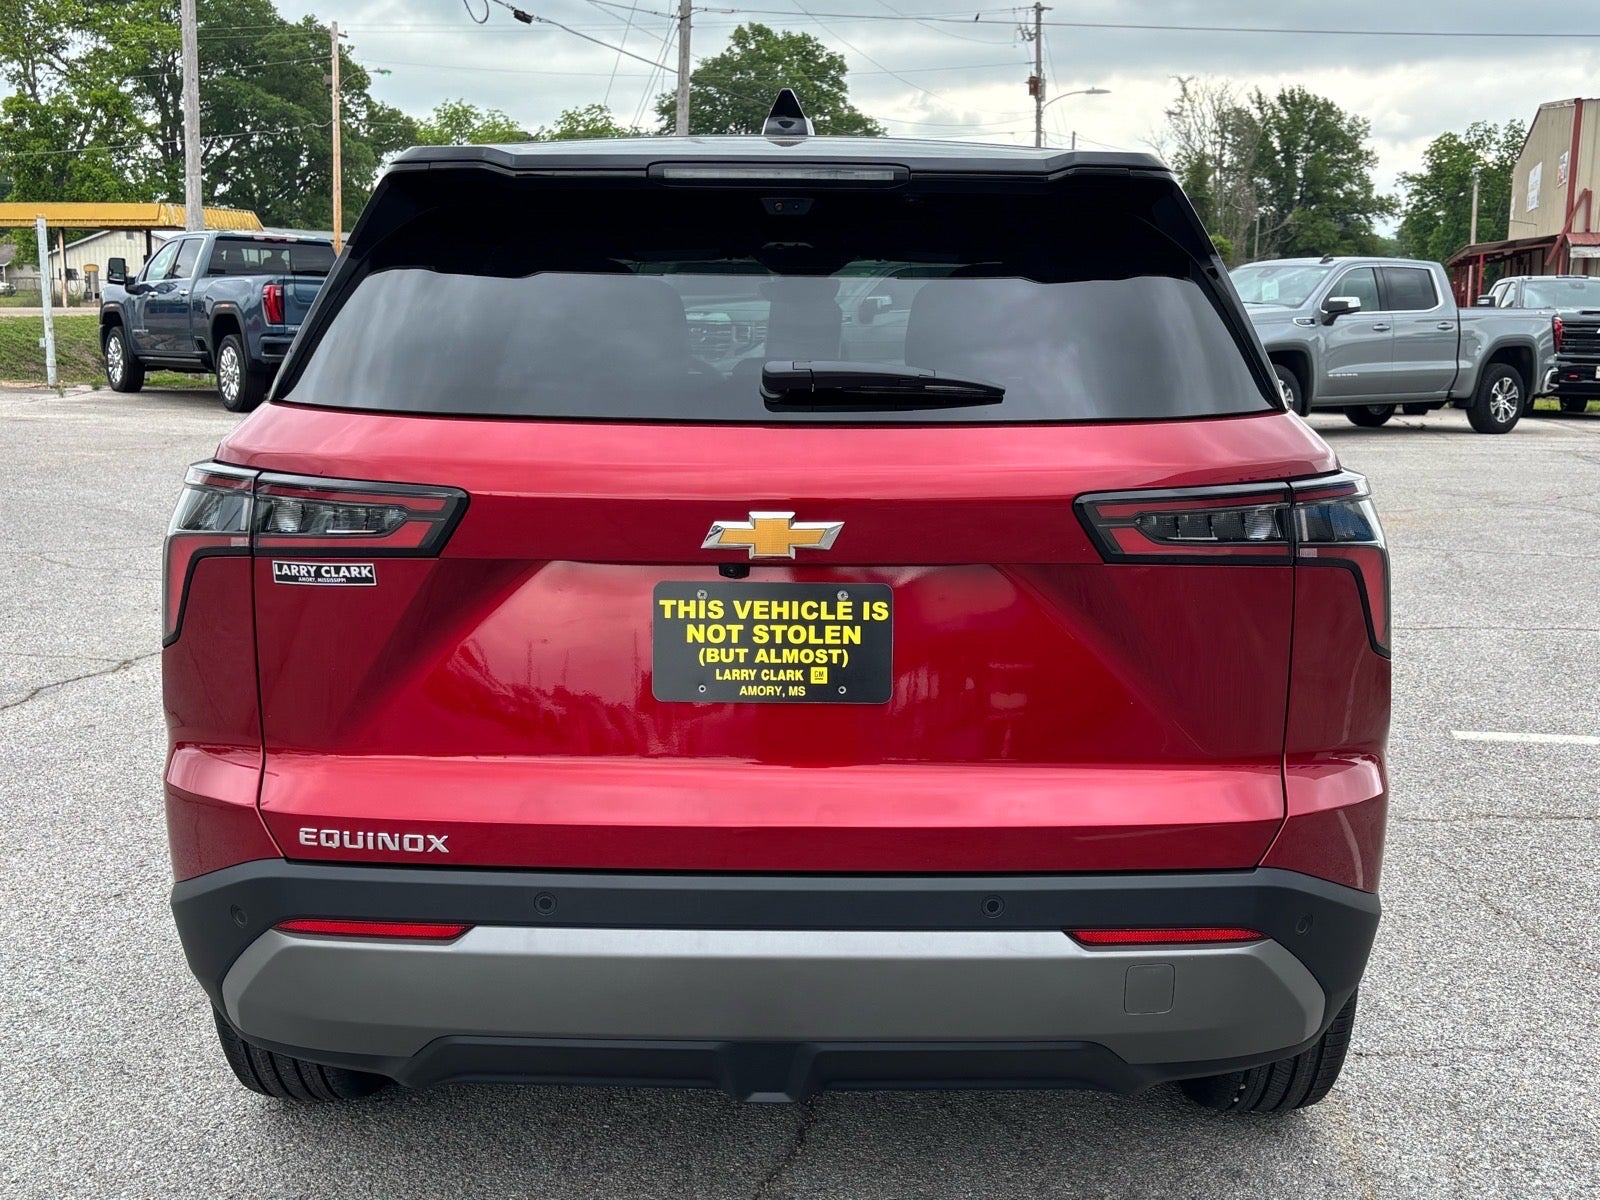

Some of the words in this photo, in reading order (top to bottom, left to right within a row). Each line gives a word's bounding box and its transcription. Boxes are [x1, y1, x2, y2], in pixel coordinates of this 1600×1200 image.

[274, 564, 317, 577] LARRY
[321, 566, 373, 578] CLARK
[659, 600, 724, 619] THIS
[733, 600, 853, 620] VEHICLE
[863, 601, 889, 621] IS
[686, 624, 744, 644] NOT
[752, 624, 861, 645] STOLEN
[698, 647, 749, 666] (BUT
[755, 648, 849, 668] ALMOST)
[715, 669, 757, 681] LARRY
[761, 669, 804, 681] CLARK
[739, 686, 786, 697] AMORY,
[789, 686, 806, 697] MS
[299, 827, 450, 853] EQUINOX
